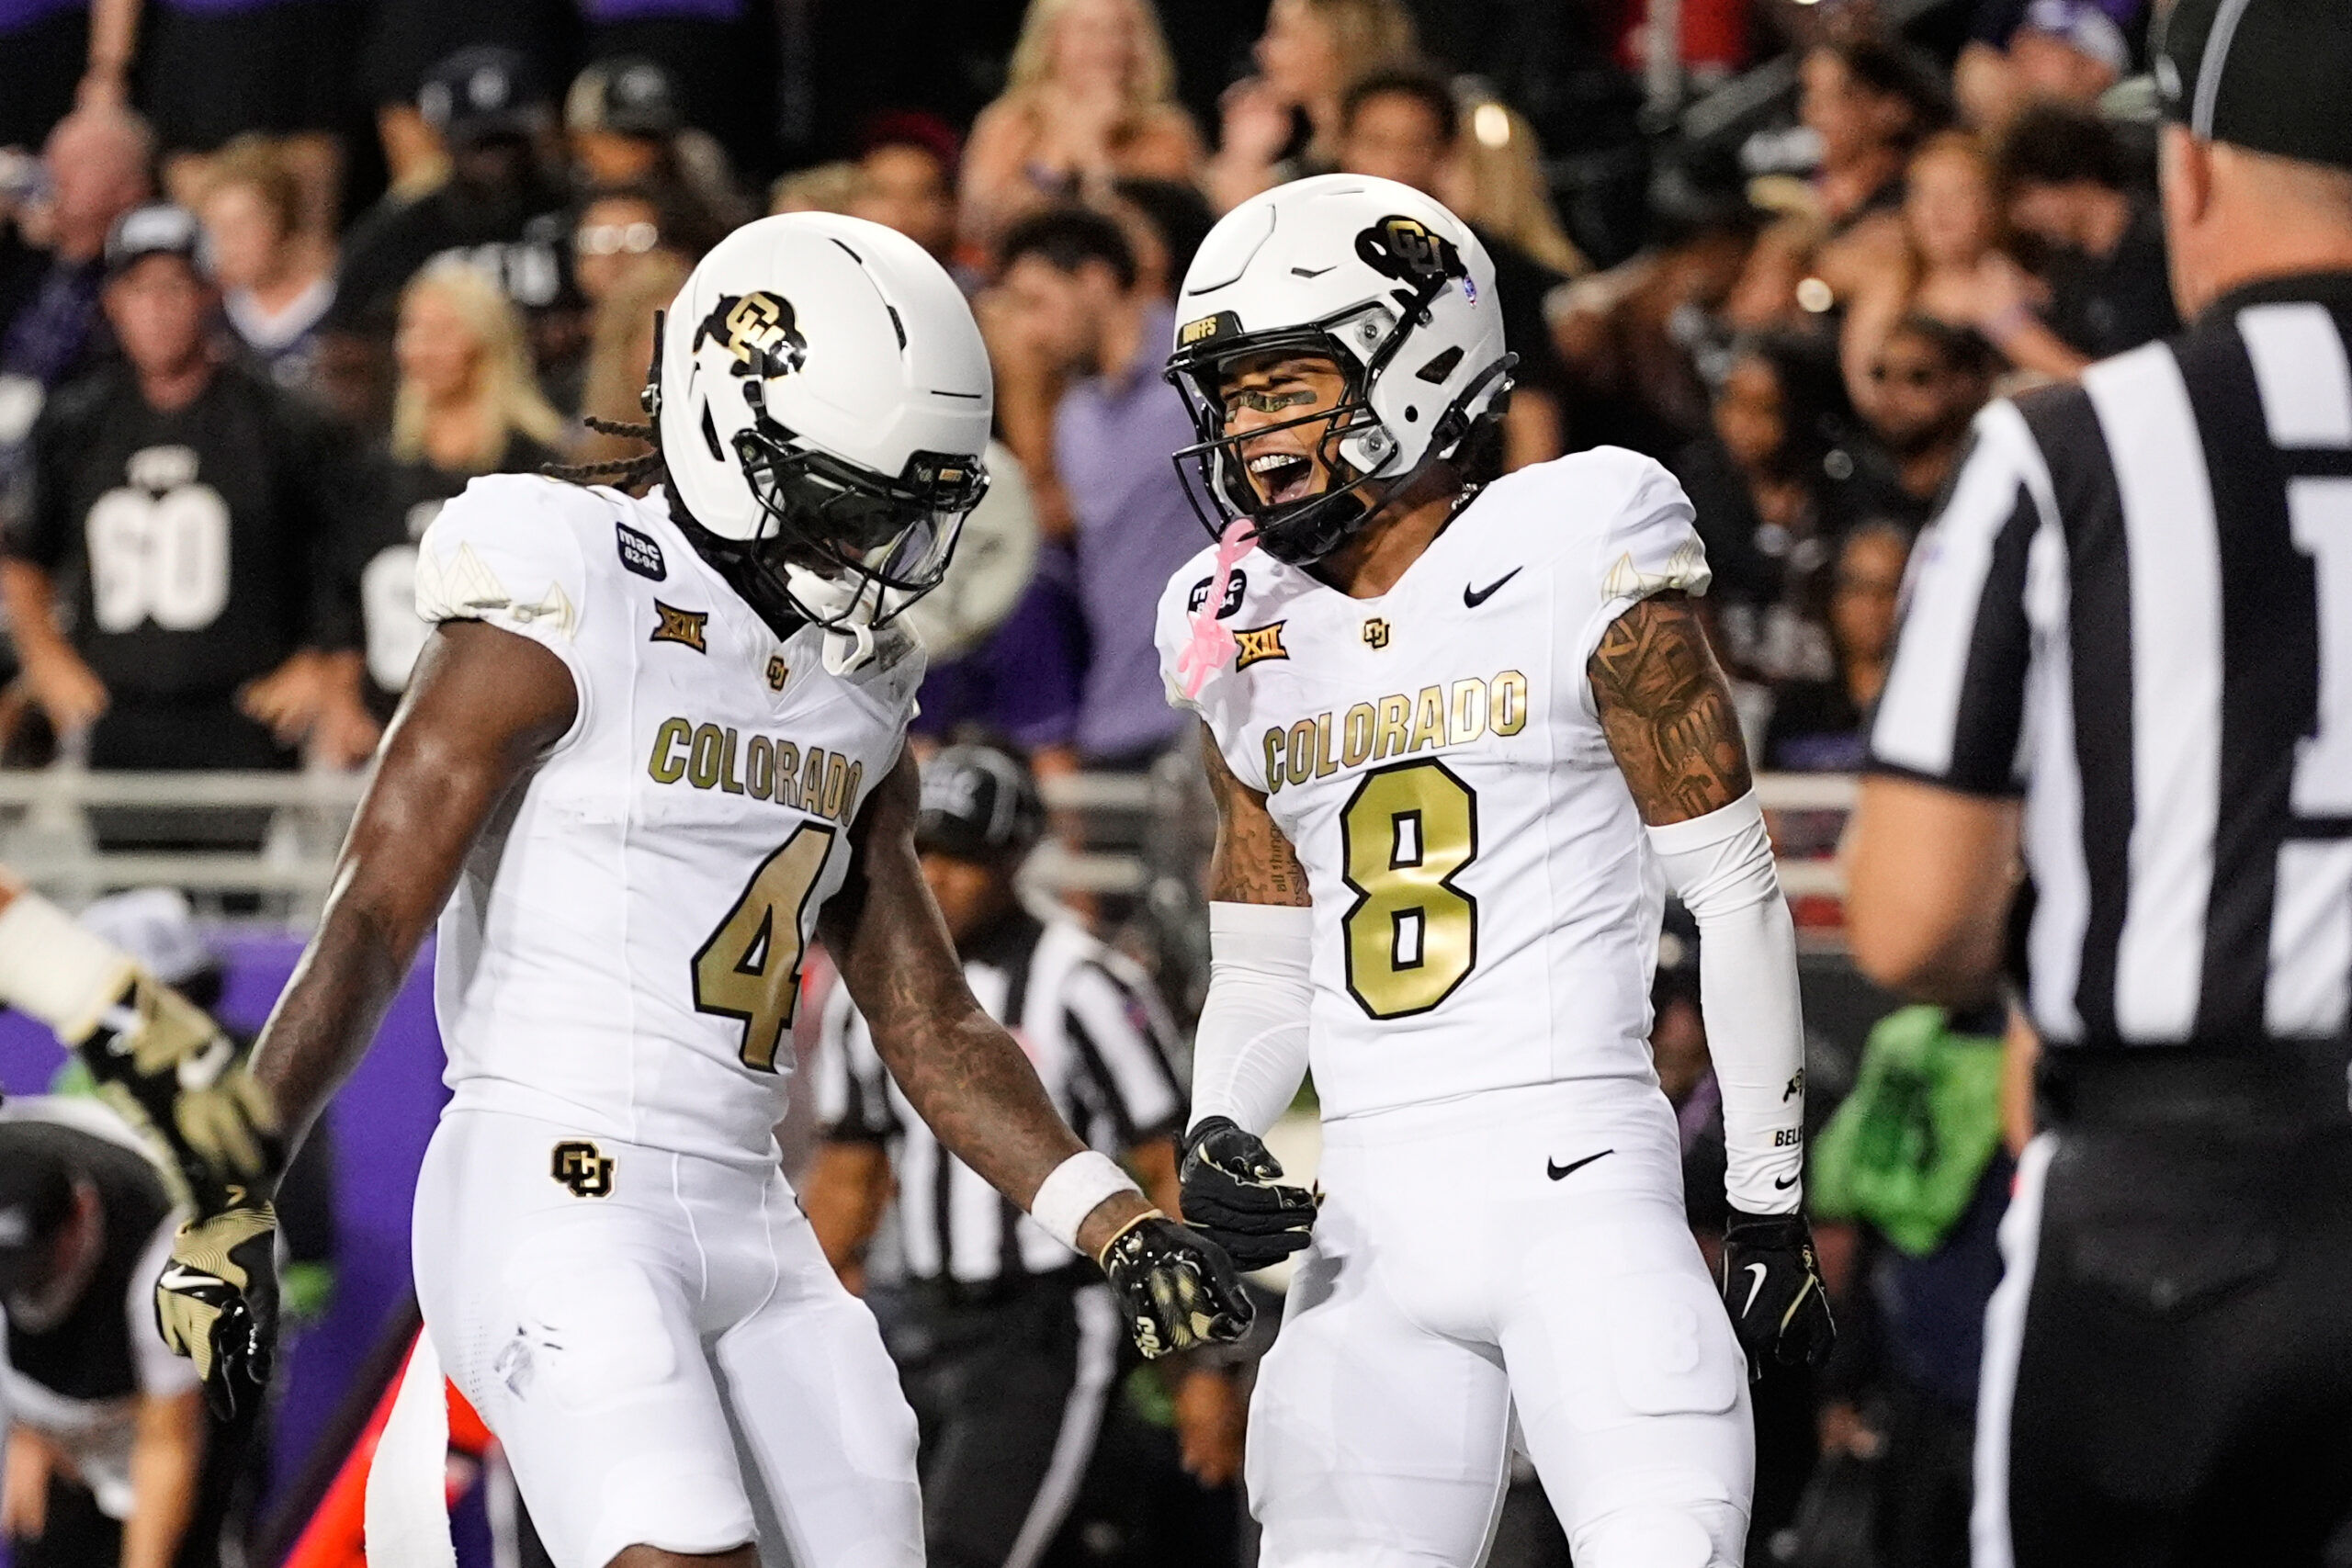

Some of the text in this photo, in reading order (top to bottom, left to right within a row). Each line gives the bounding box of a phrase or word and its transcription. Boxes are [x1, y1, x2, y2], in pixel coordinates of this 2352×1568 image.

[617, 527, 662, 561] mac
[1193, 579, 1243, 603] mc
[1233, 622, 1289, 671] XII
[648, 716, 862, 827] COLORADO
[1262, 670, 1527, 795] COLORADO
[1340, 756, 1478, 1020] 8
[691, 819, 837, 1075] 4
[551, 1141, 615, 1198] CU
